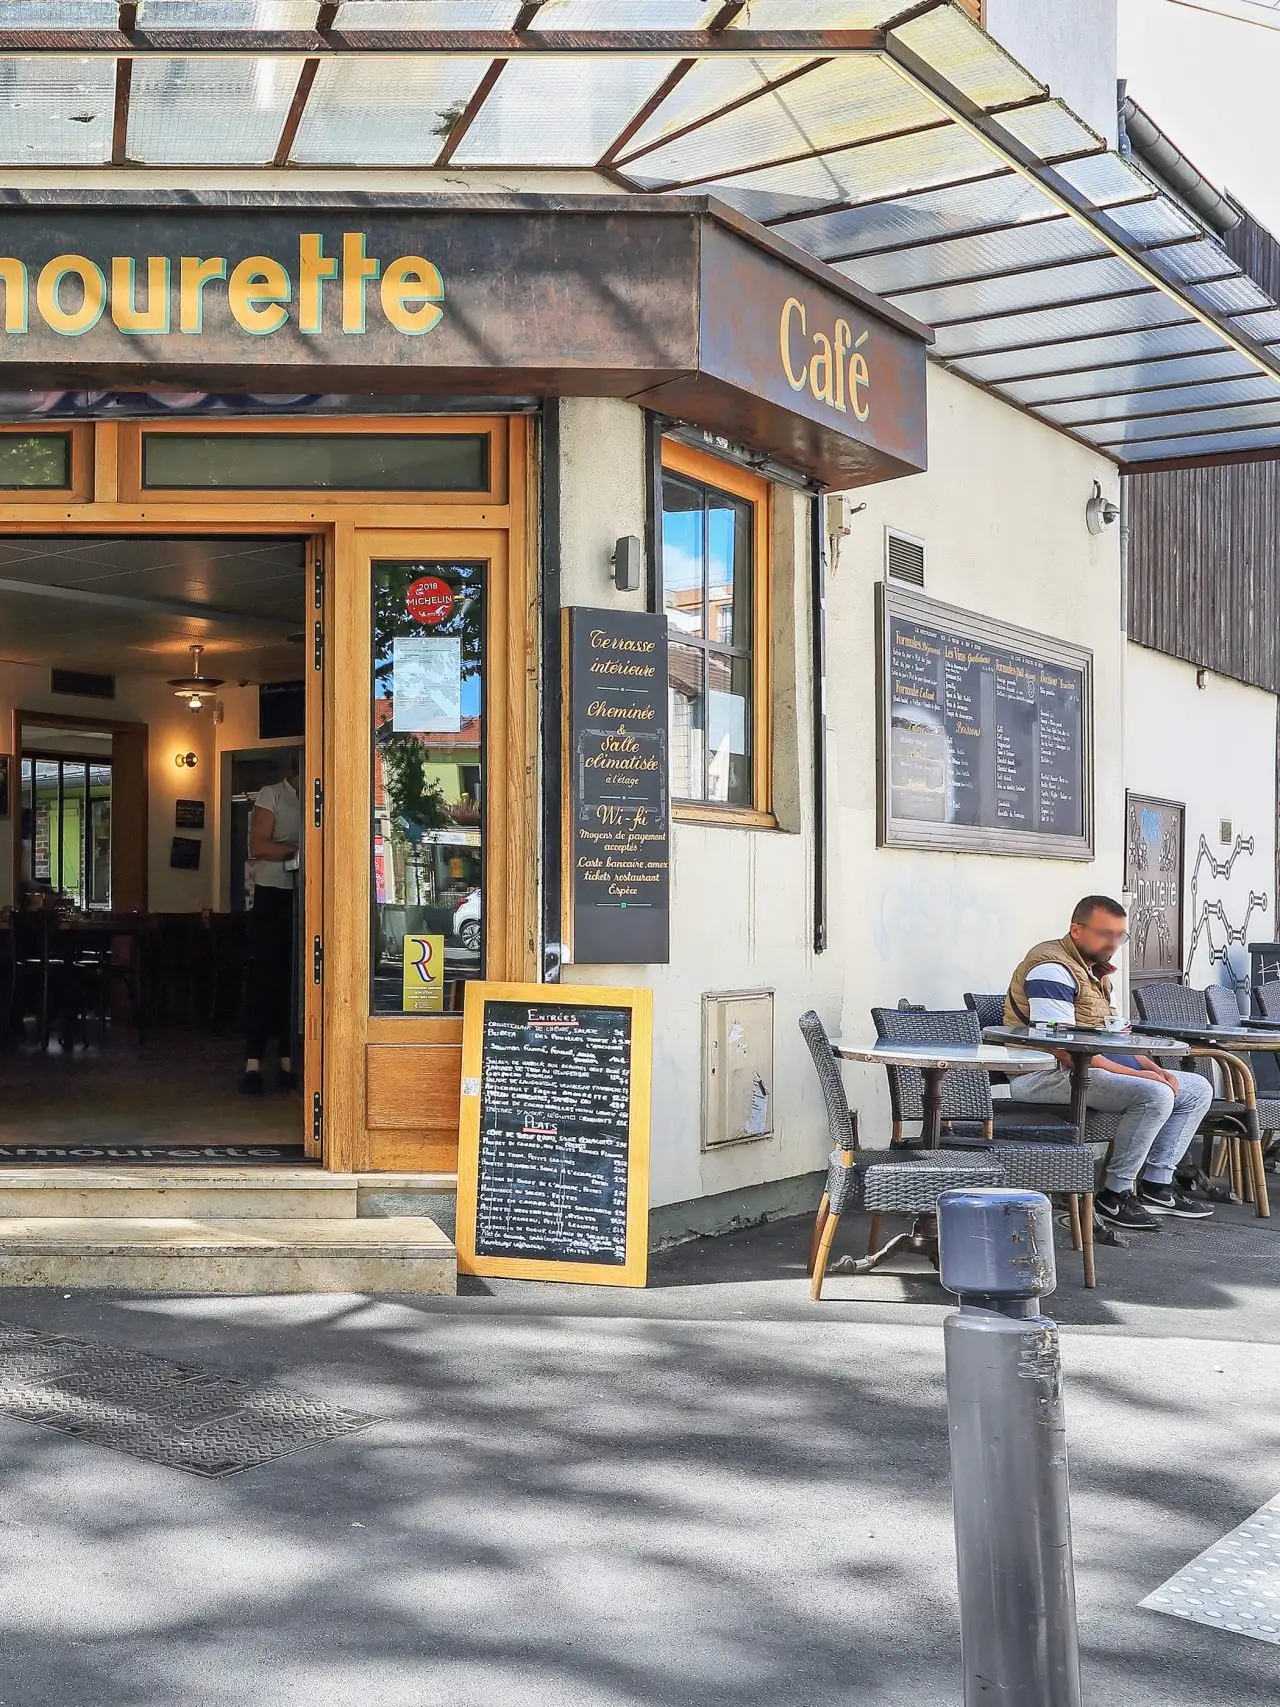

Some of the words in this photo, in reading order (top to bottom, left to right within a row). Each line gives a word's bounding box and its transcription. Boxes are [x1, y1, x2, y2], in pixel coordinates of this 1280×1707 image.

[780, 297, 870, 422] Café
[405, 595, 452, 606] MICHELIN
[589, 629, 655, 653] Terrasse
[589, 657, 656, 678] intérieure
[587, 700, 656, 720] Cheminée
[616, 724, 627, 735] &
[600, 735, 640, 753] Salle
[584, 752, 659, 771] climatisée
[605, 773, 613, 783] à
[613, 773, 640, 789] l'étage
[578, 829, 613, 844] Moyens
[615, 830, 626, 841] de
[628, 830, 666, 844] payement
[577, 857, 604, 869] Carte
[583, 869, 611, 882] tickets
[614, 871, 660, 882] restaurant
[608, 883, 639, 897] Espèce
[524, 1115, 558, 1130] PLATS
